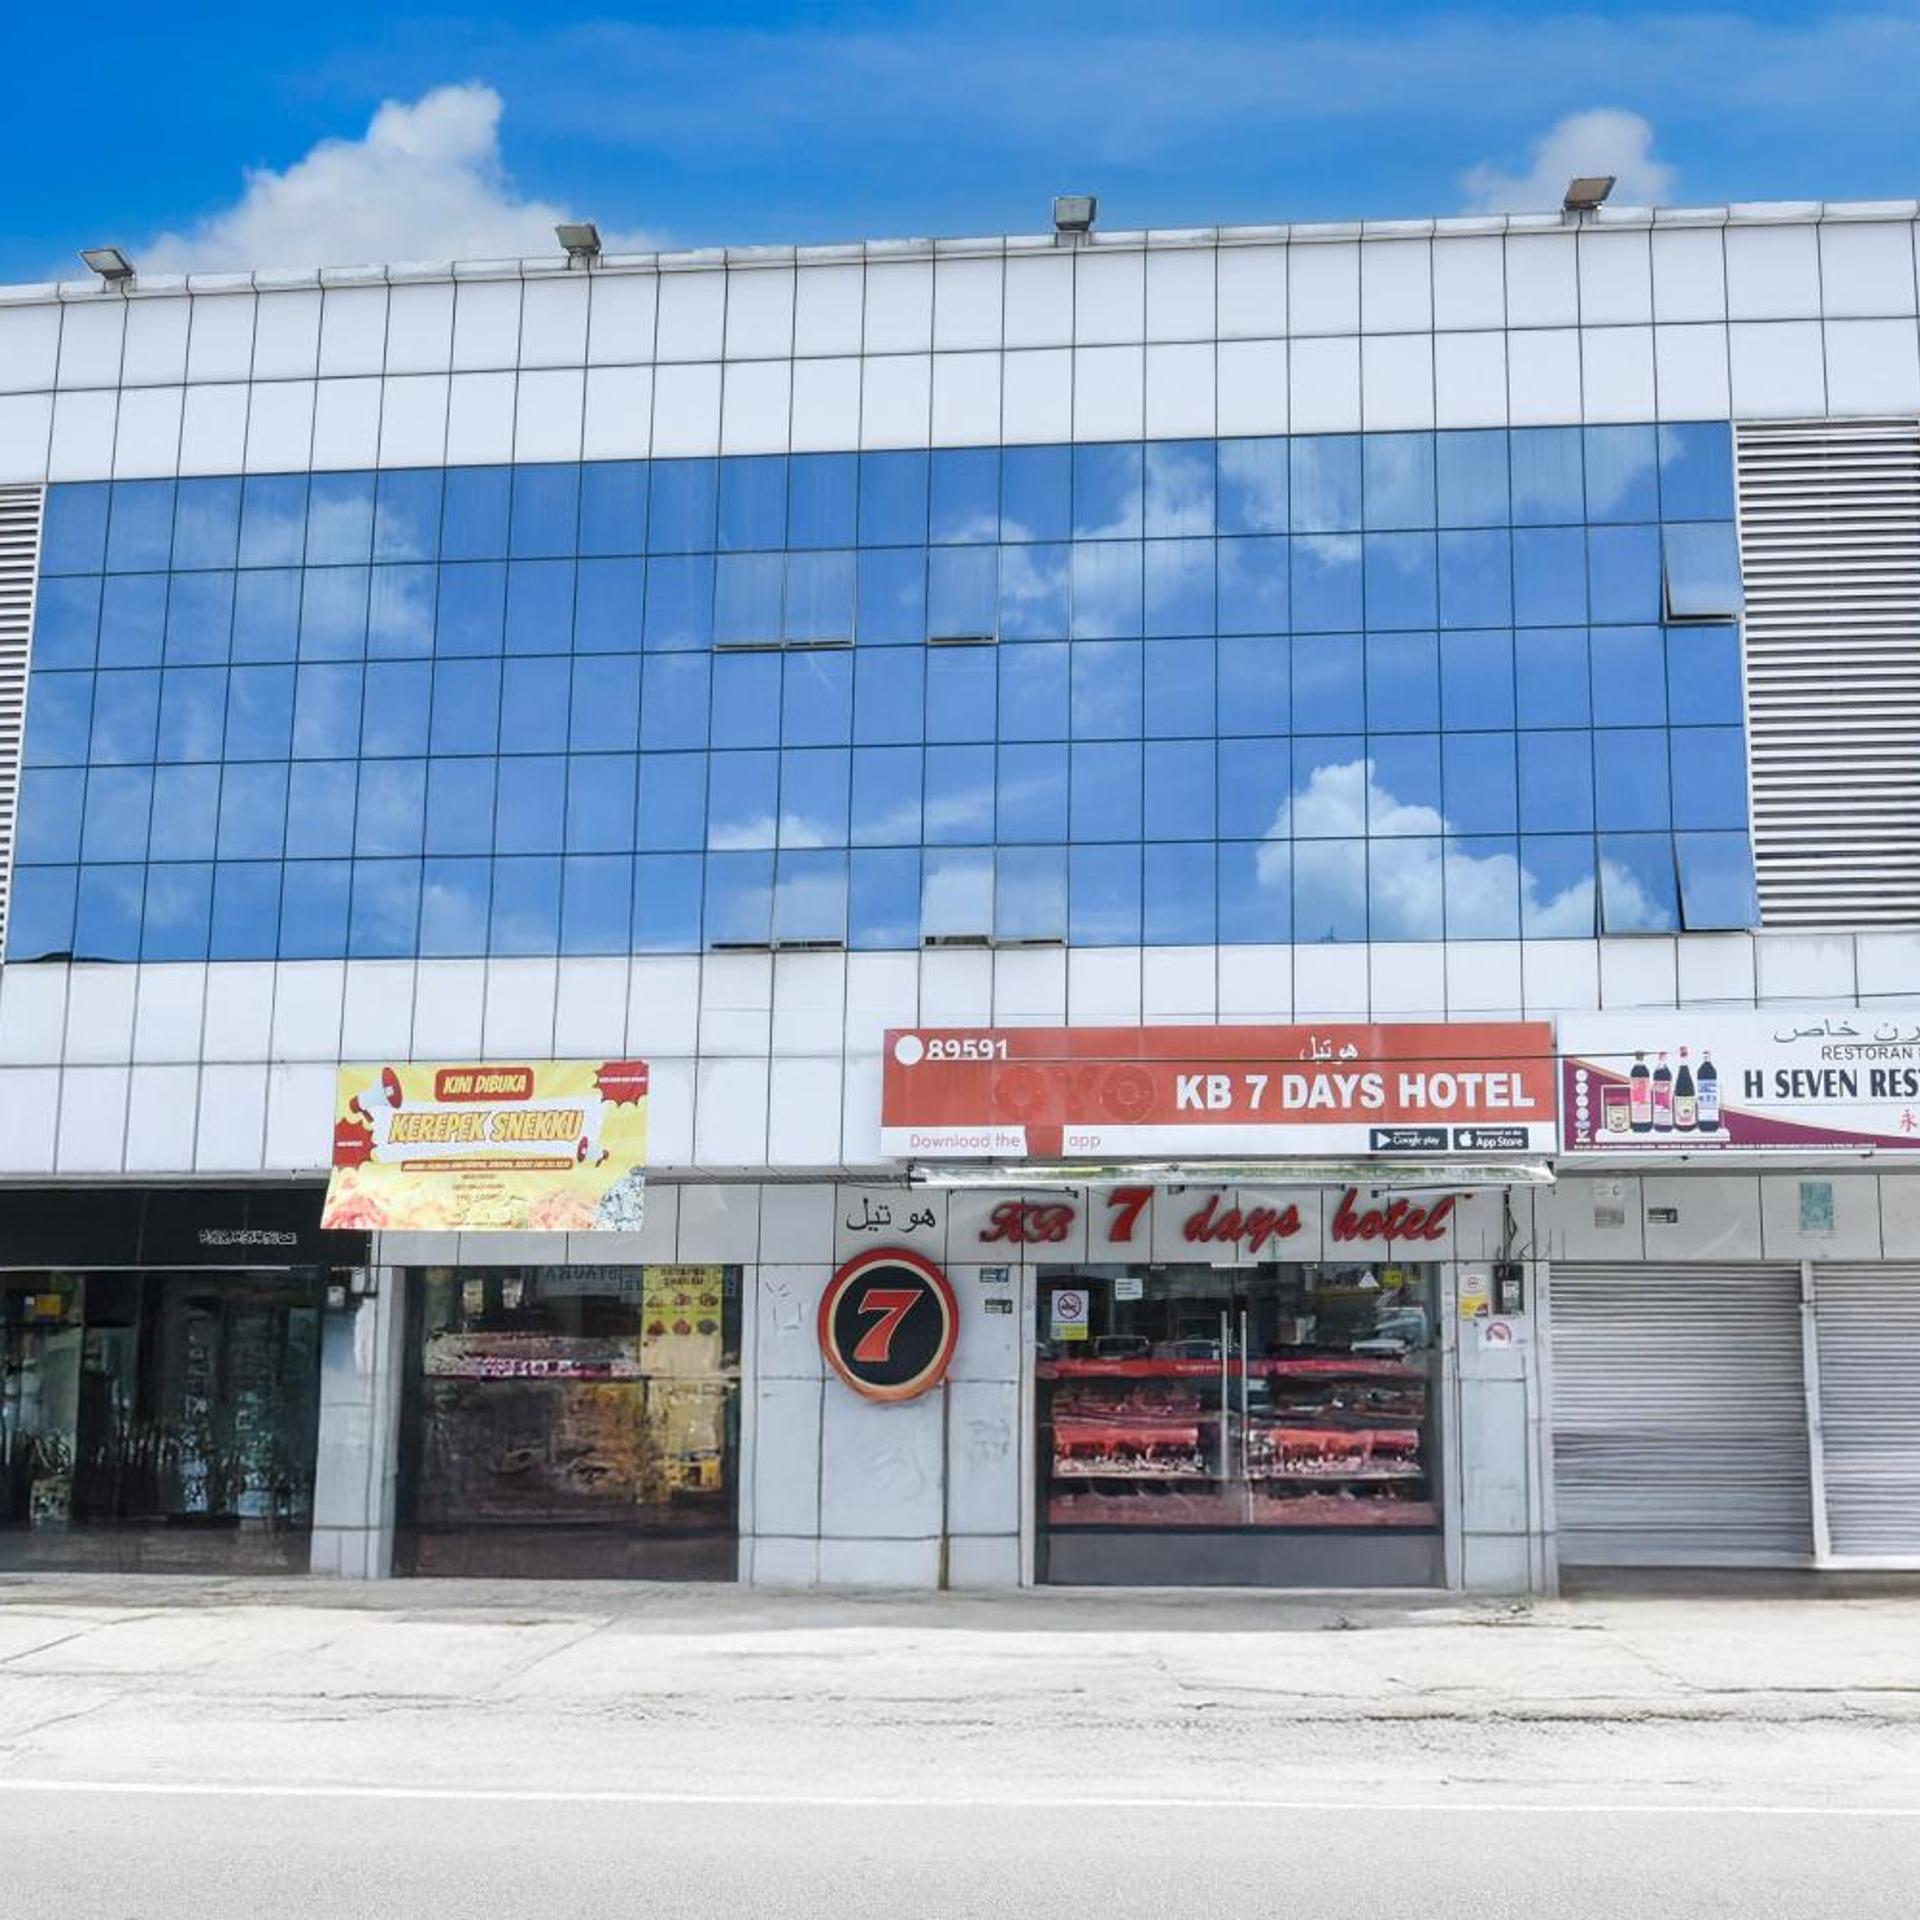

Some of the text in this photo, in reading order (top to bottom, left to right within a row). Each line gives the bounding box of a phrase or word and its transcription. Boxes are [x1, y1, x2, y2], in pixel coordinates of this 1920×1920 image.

[926, 1039, 1008, 1060] 89591
[1821, 1046, 1912, 1061] RESTORAN
[443, 1074, 527, 1095] KINI DIBUKA
[1176, 1072, 1535, 1110] KB 7 DAYS HOTEL
[1744, 1069, 1764, 1099] H
[1775, 1069, 1857, 1099] SEVEN
[388, 1109, 584, 1144] KEREPEK SNEKKU
[910, 1133, 1101, 1149] Download the app
[1476, 1136, 1524, 1149] App Store
[1106, 1187, 1154, 1243] 7
[1184, 1194, 1302, 1254] days
[1332, 1187, 1456, 1241] hotel
[853, 1289, 924, 1362] 7
